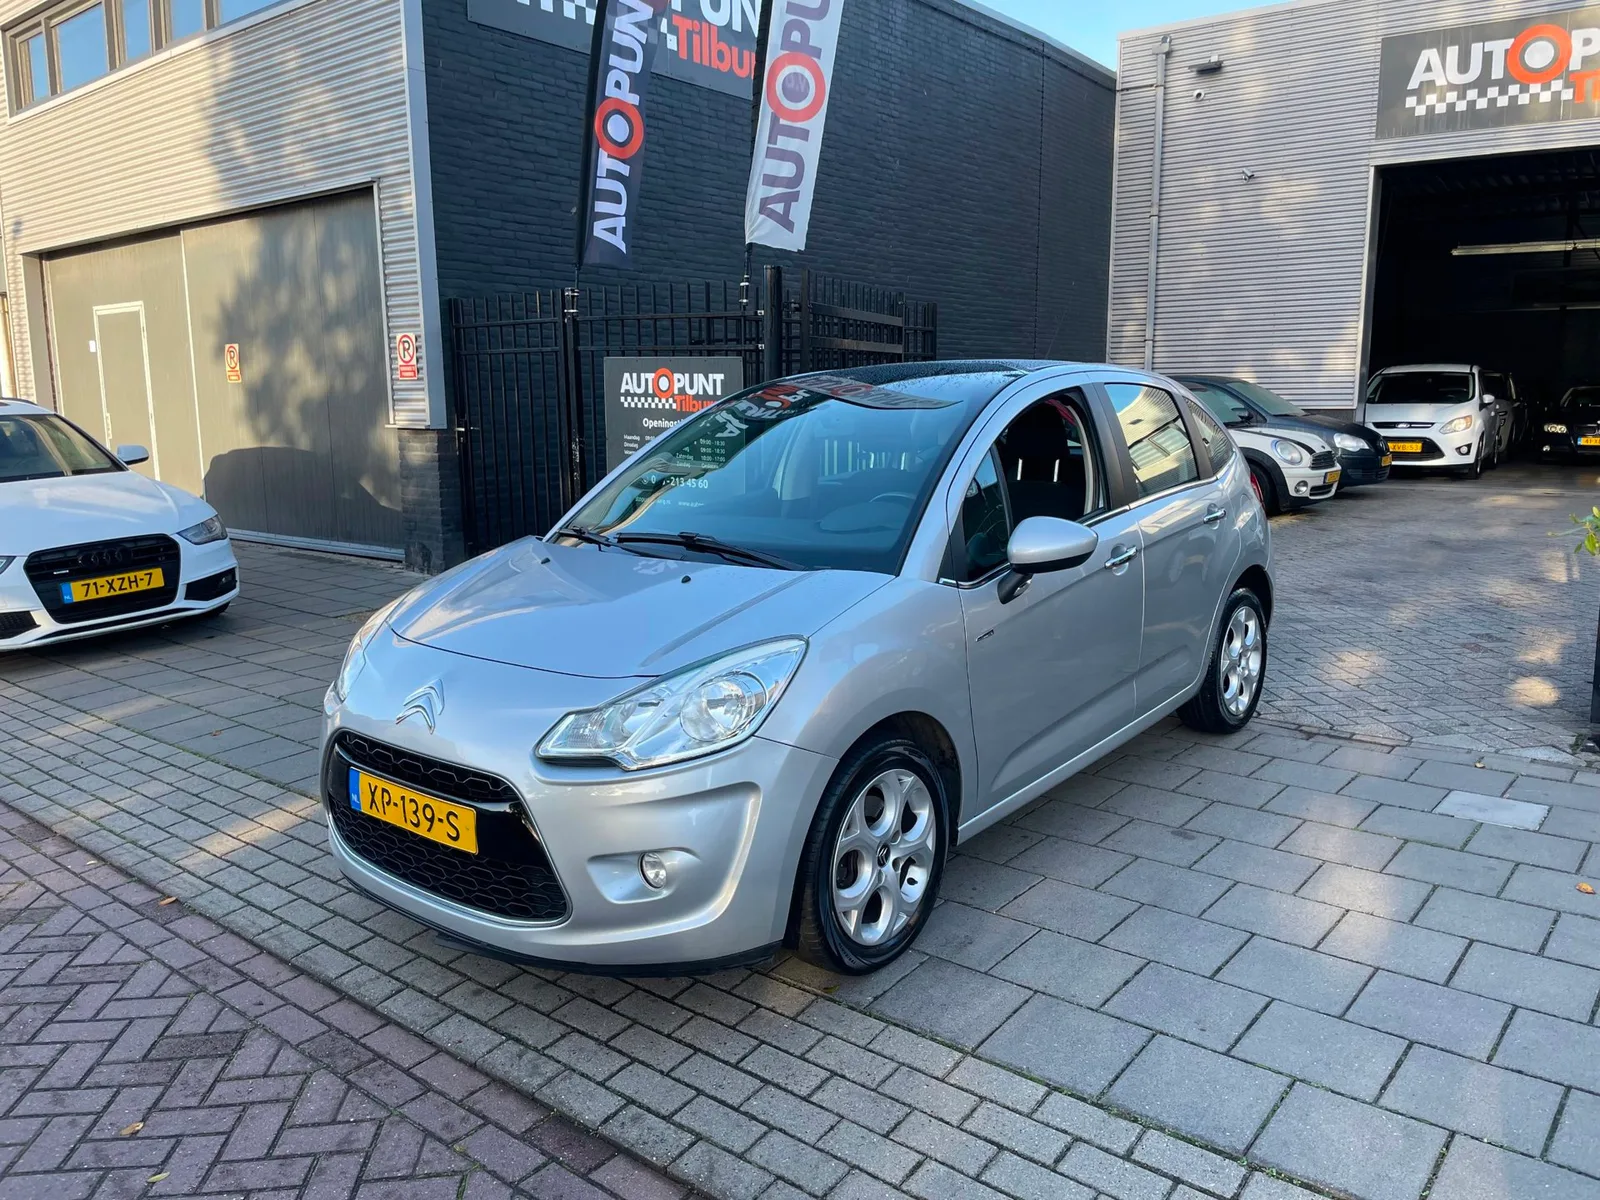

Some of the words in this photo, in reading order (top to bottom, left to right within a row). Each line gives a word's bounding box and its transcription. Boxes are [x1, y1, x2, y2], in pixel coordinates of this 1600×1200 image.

[1406, 24, 1600, 90] AUTOP
[620, 368, 725, 399] AUTOPUNT
[698, 479, 708, 489] 60
[81, 572, 153, 597] 71-XZH-7
[367, 782, 460, 842] XP-139-S
